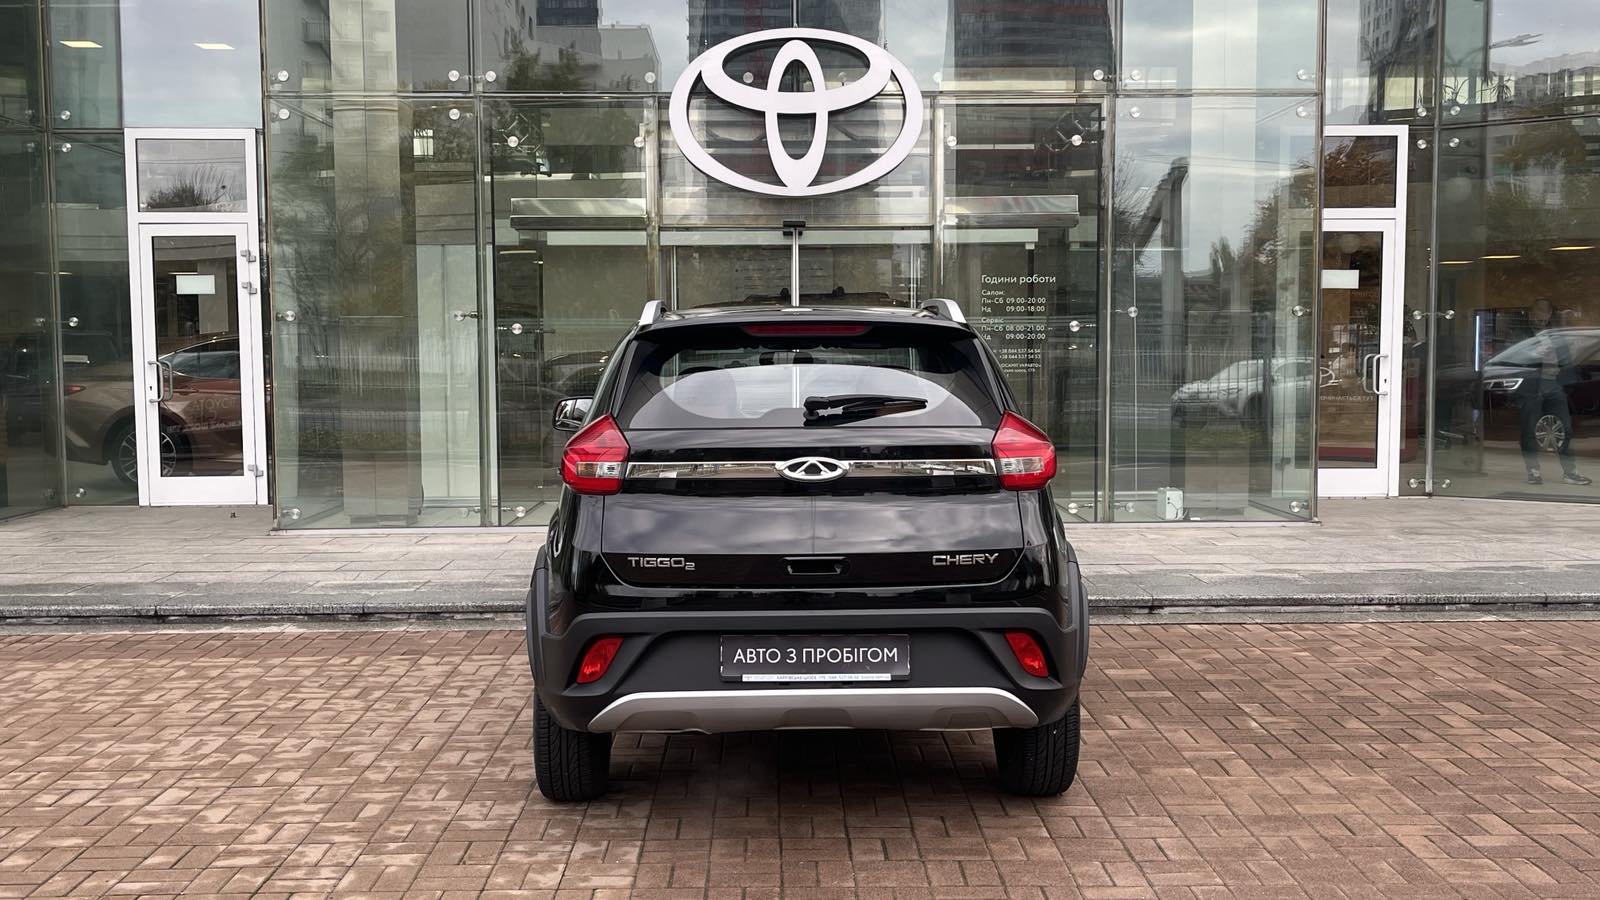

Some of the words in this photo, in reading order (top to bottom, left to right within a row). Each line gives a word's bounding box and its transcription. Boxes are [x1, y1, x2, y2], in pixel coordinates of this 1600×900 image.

[981, 274, 1017, 285] Години
[1019, 274, 1056, 285] роботи
[932, 552, 999, 566] CHERY
[733, 648, 781, 663] АВТО
[786, 648, 797, 663] З
[803, 648, 898, 663] ПРОБІГОМ
